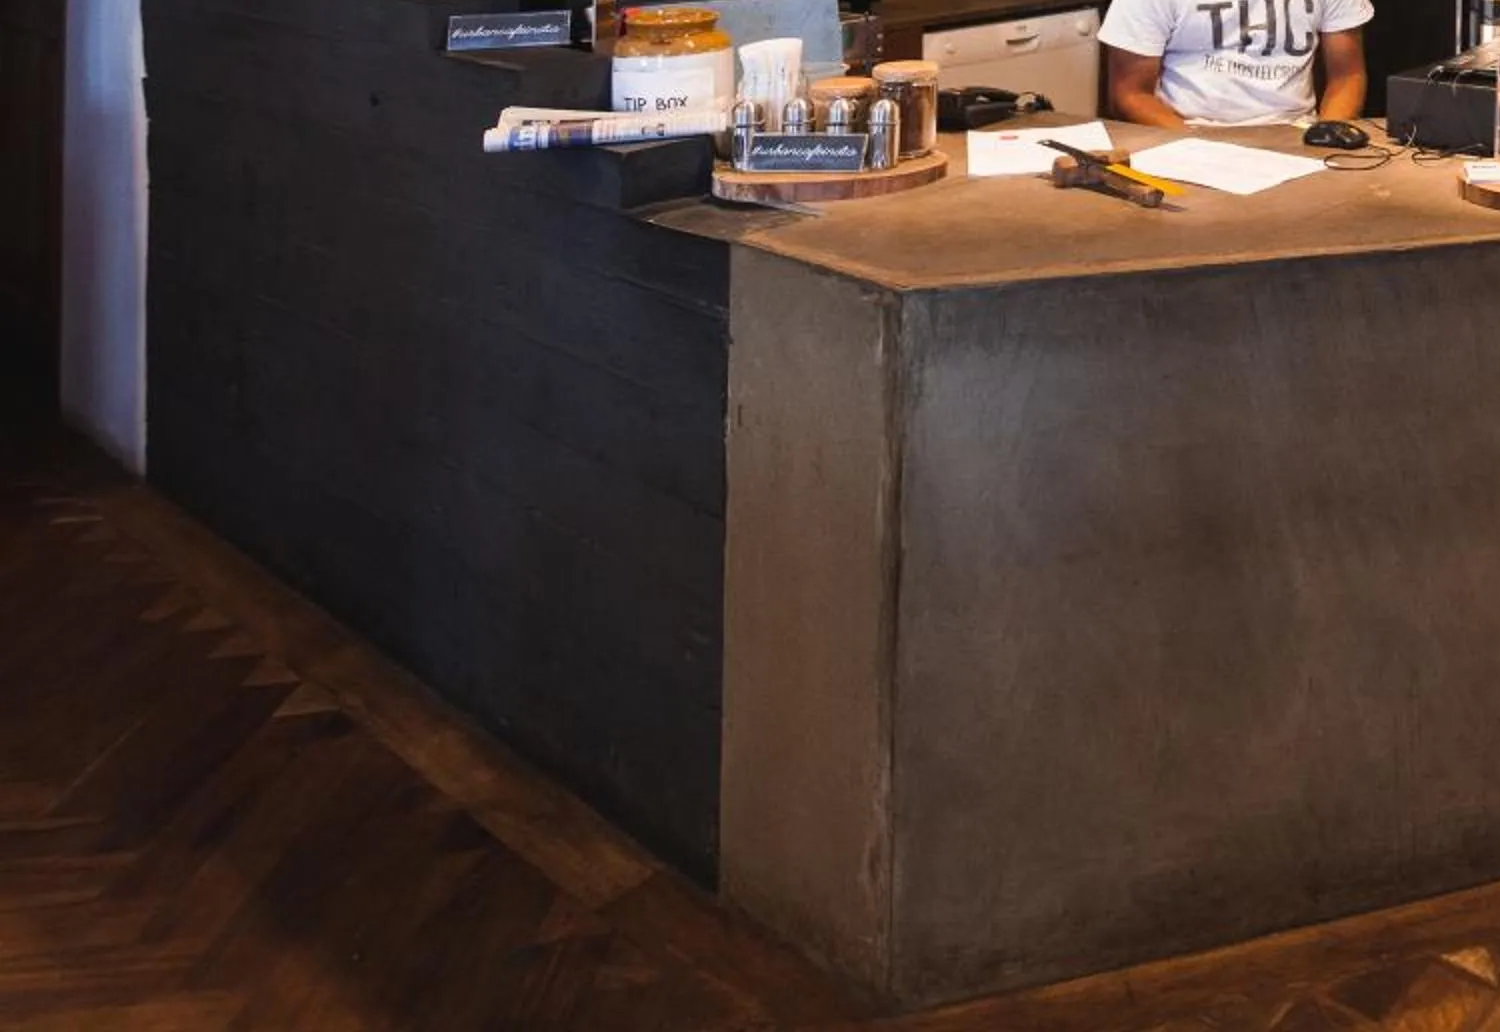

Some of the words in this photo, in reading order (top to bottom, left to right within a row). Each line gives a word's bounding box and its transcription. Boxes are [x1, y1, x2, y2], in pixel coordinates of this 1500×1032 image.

[1204, 53, 1224, 73] THE
[623, 95, 648, 114] TIP
[654, 94, 690, 111] BOX
